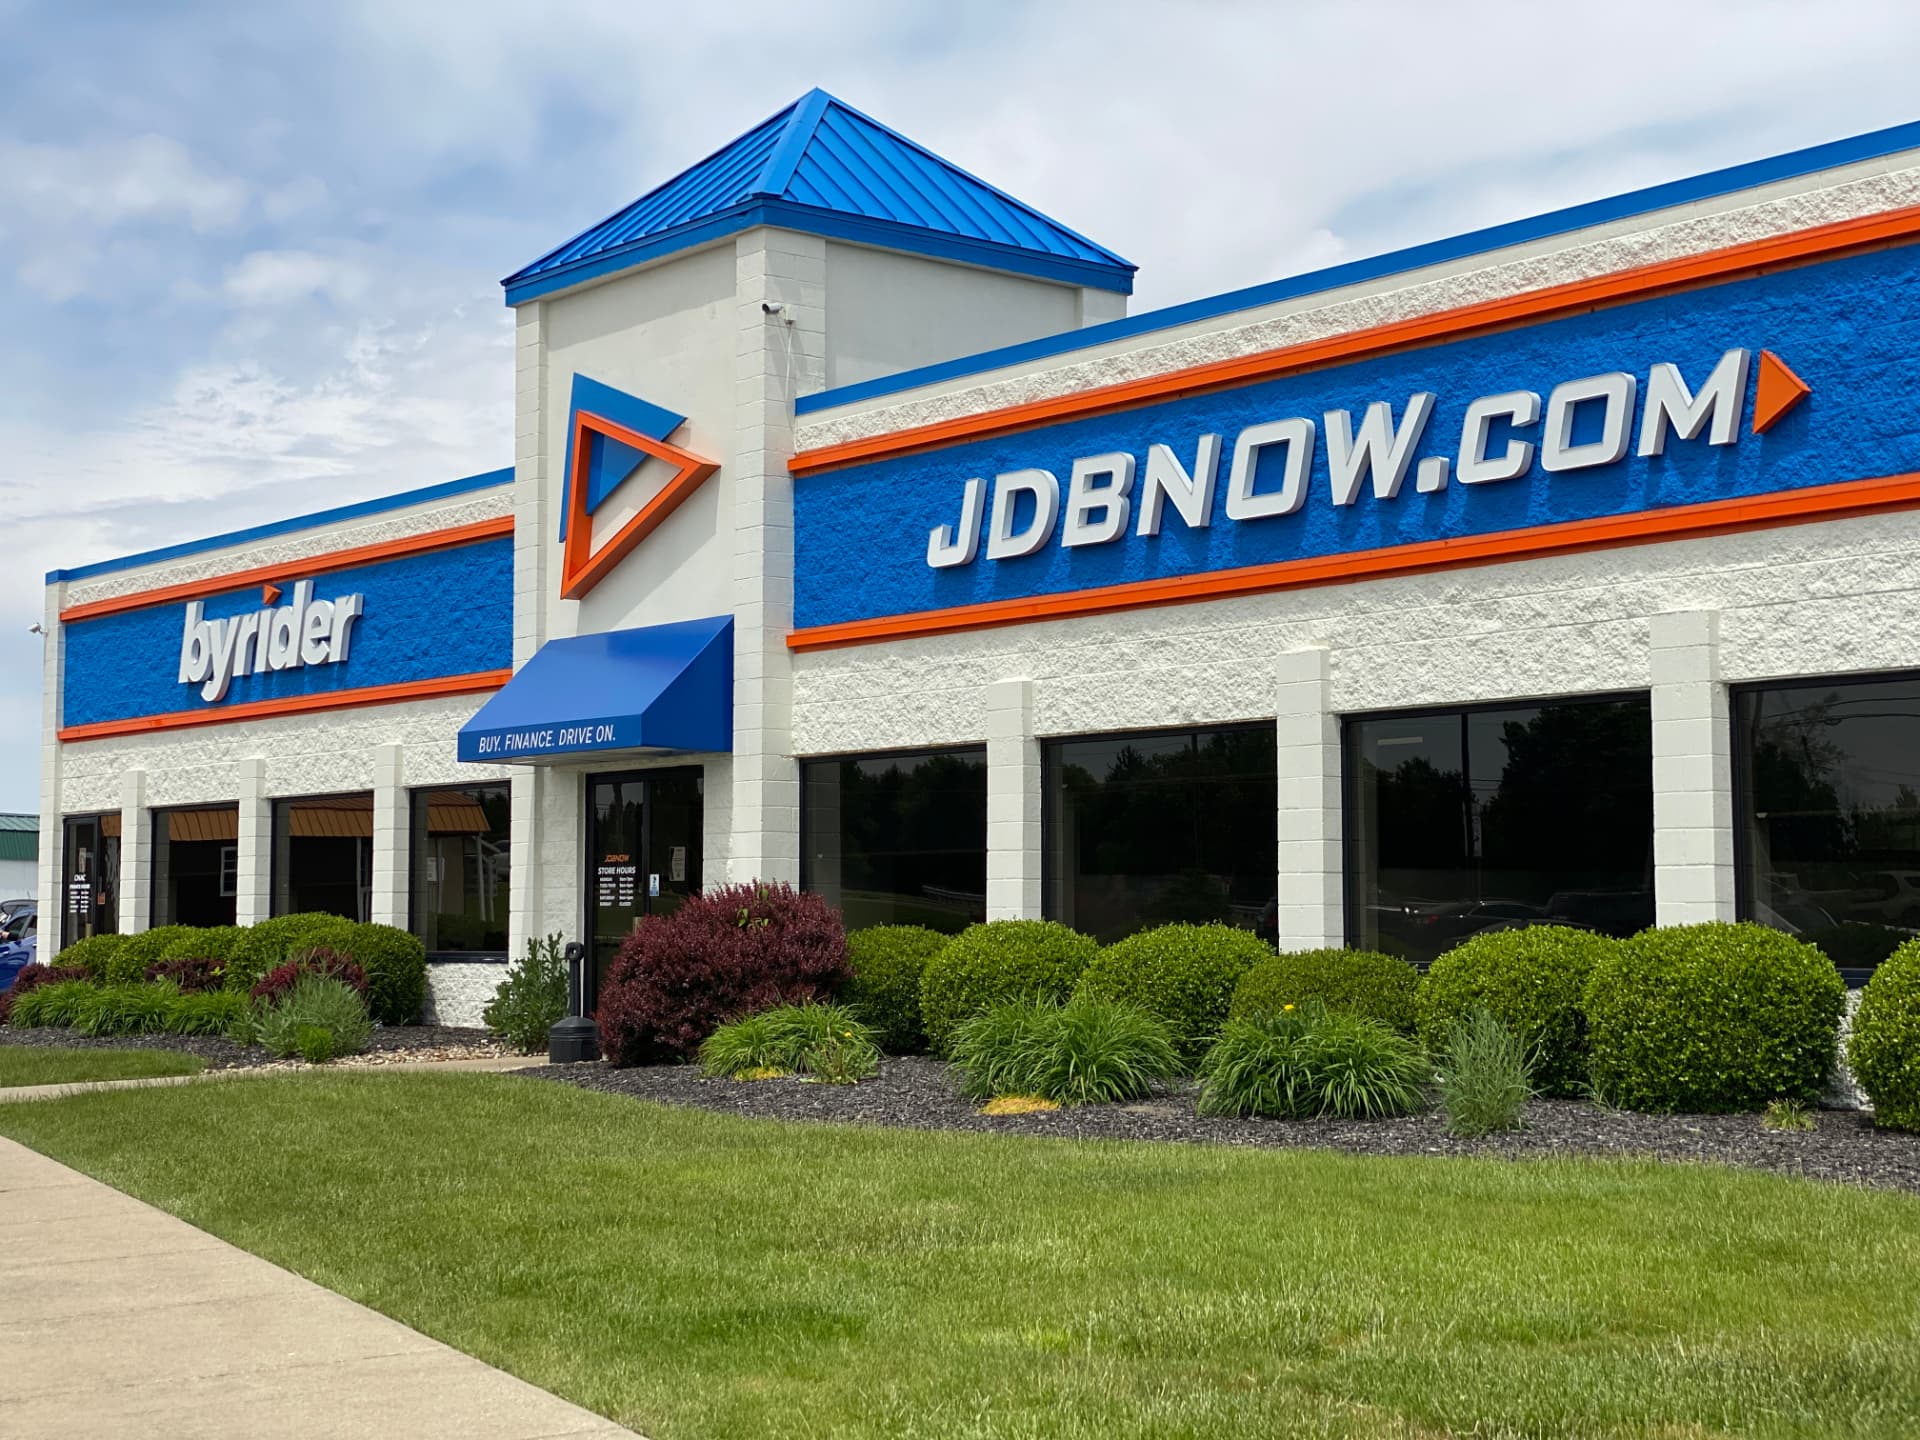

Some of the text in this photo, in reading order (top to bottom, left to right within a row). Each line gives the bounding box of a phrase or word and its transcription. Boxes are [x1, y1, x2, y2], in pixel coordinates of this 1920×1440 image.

[927, 347, 1750, 568] JDBNOW.COM
[178, 579, 364, 702] byrider
[479, 724, 616, 753] BUY. FINANCE. DRIVE ON.
